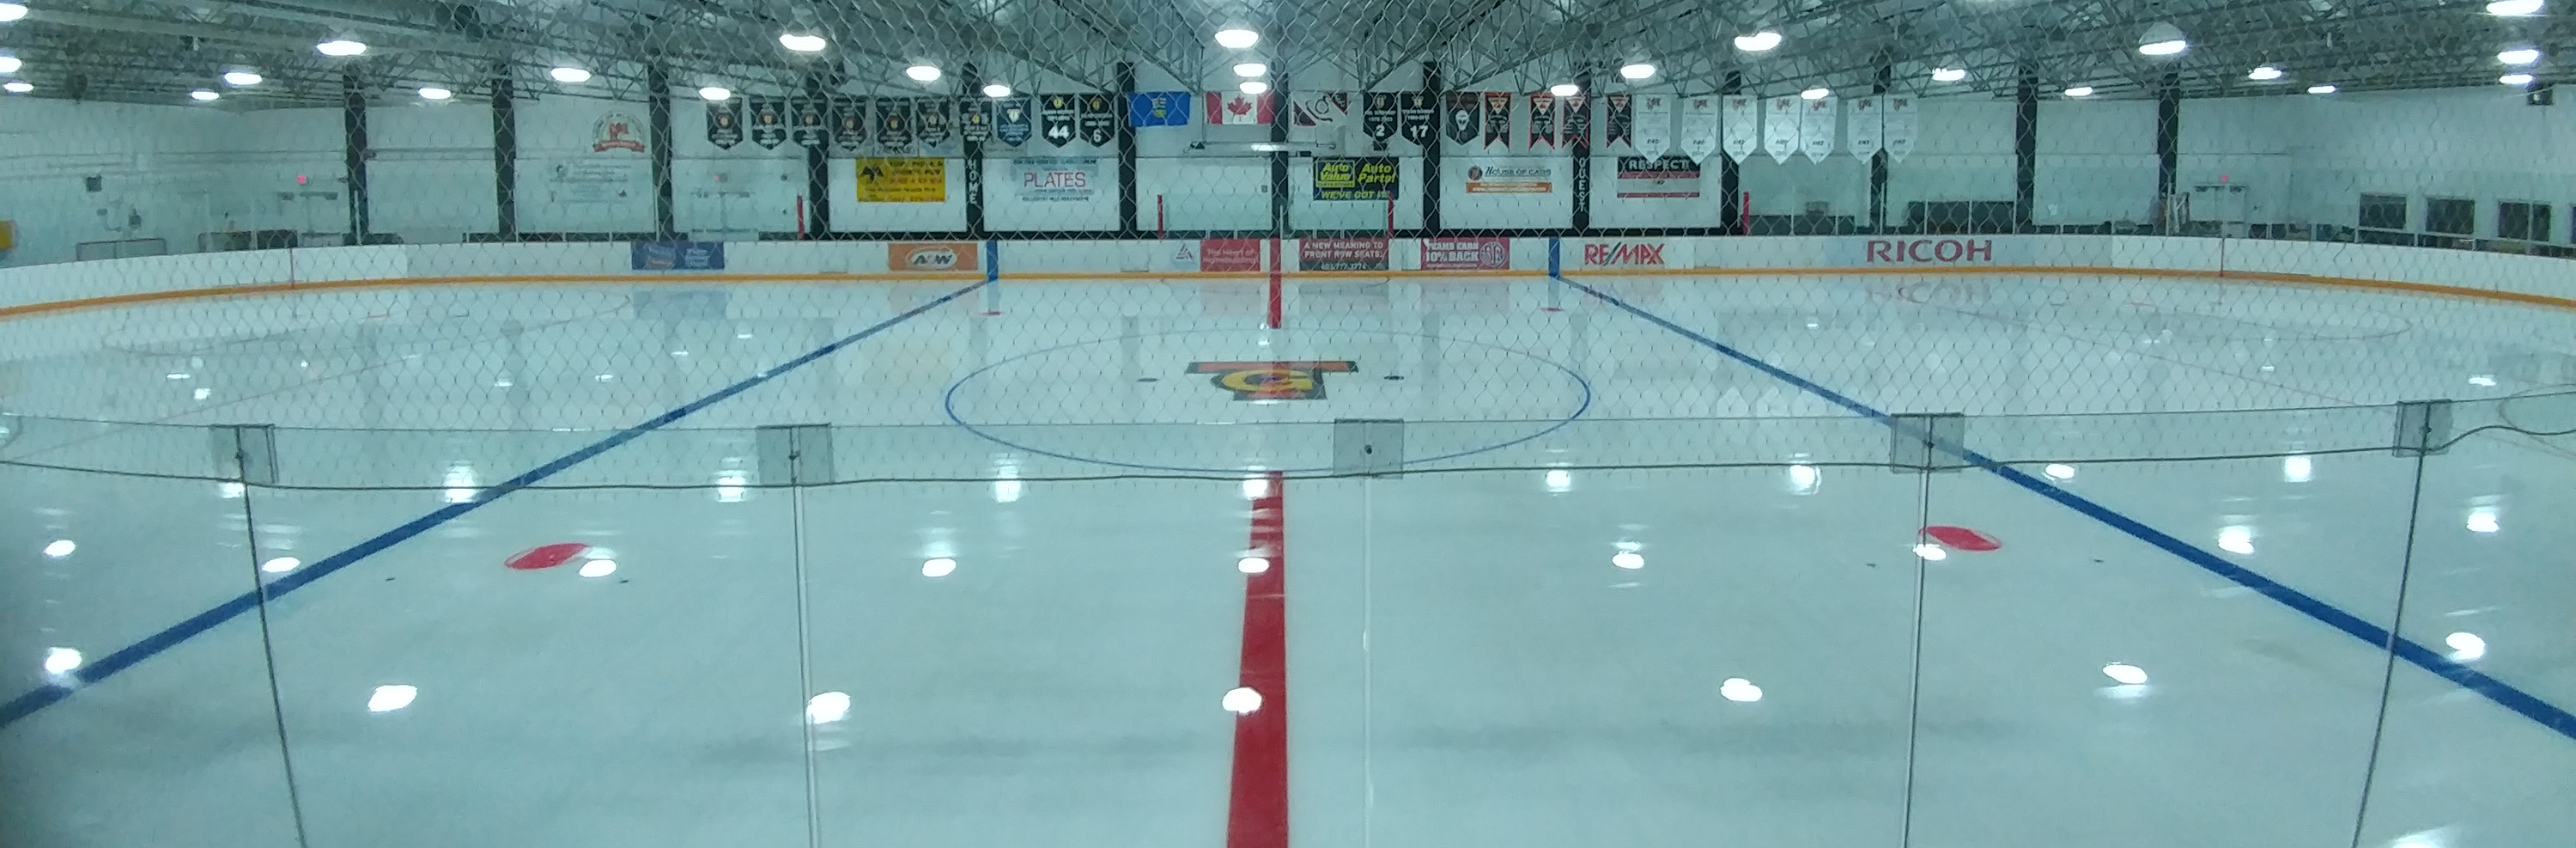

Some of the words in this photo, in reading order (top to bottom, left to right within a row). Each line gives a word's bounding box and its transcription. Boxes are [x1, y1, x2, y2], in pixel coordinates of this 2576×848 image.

[1048, 125, 1070, 139] 44
[1093, 129, 1102, 143] 6
[1376, 124, 1385, 137] 2
[1411, 125, 1429, 137] 17
[1322, 162, 1350, 172] Auto
[1362, 163, 1392, 173] Auto
[968, 159, 978, 204] HOME
[1024, 172, 1086, 187] PLATES
[1321, 172, 1352, 181] Value
[1354, 191, 1376, 199] GOT
[1426, 252, 1448, 262] 10%
[1449, 252, 1479, 262] BACK
[1584, 241, 1665, 265] RE/MAX
[1867, 240, 1992, 262] RICOH
